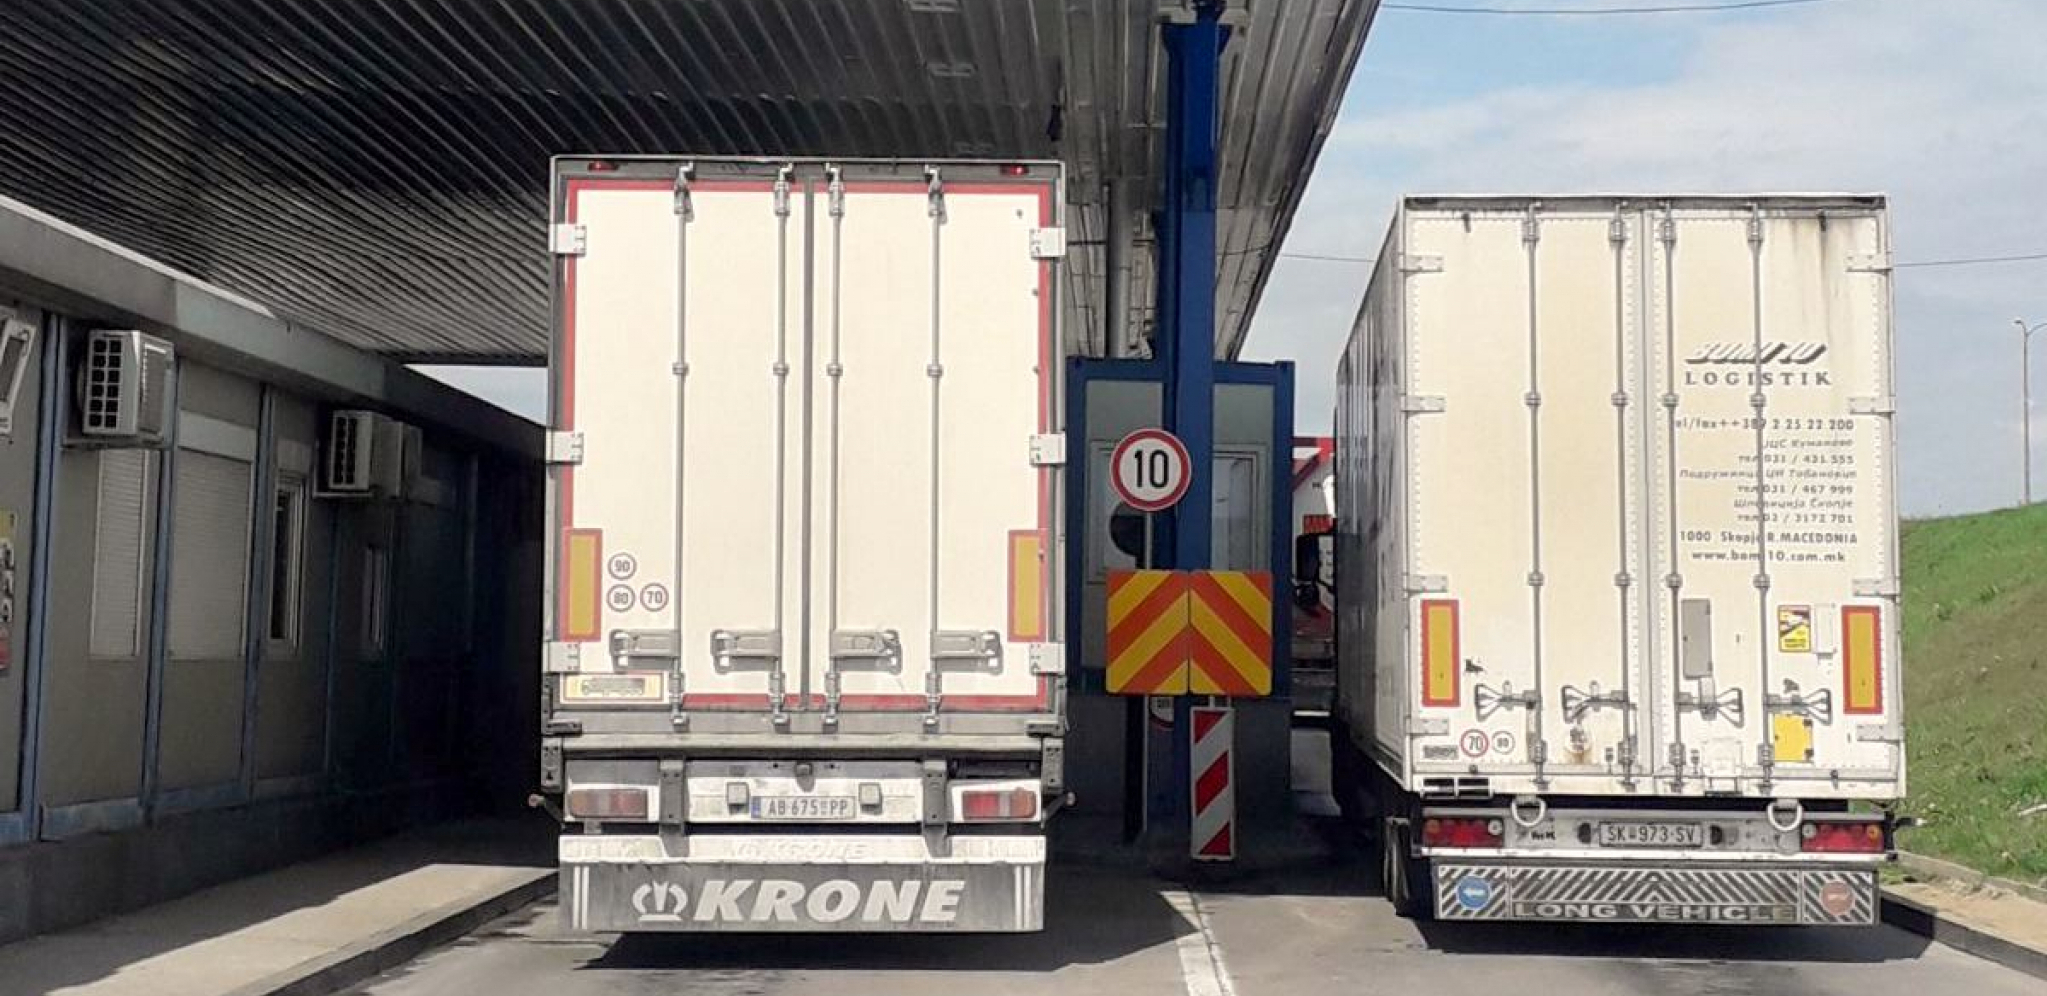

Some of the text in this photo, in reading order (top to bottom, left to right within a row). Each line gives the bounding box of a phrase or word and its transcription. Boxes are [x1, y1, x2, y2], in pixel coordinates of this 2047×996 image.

[1684, 372, 1832, 386] LOGISTIK
[1772, 419, 1780, 430] 2
[1785, 419, 1802, 430] 25
[1807, 419, 1823, 430] 22
[1829, 419, 1855, 431] 200
[1133, 449, 1170, 488] 10
[1801, 485, 1826, 494] 467
[1680, 531, 1712, 542] 1000
[1767, 532, 1858, 544] R.MACEDONIA
[1692, 550, 1847, 563] www.bom10.com.mk
[614, 559, 631, 573] 90
[646, 590, 663, 604] 70
[1469, 735, 1484, 751] 70
[693, 879, 966, 923] KRONE
[1514, 902, 1796, 921] LONG VEHICLE
